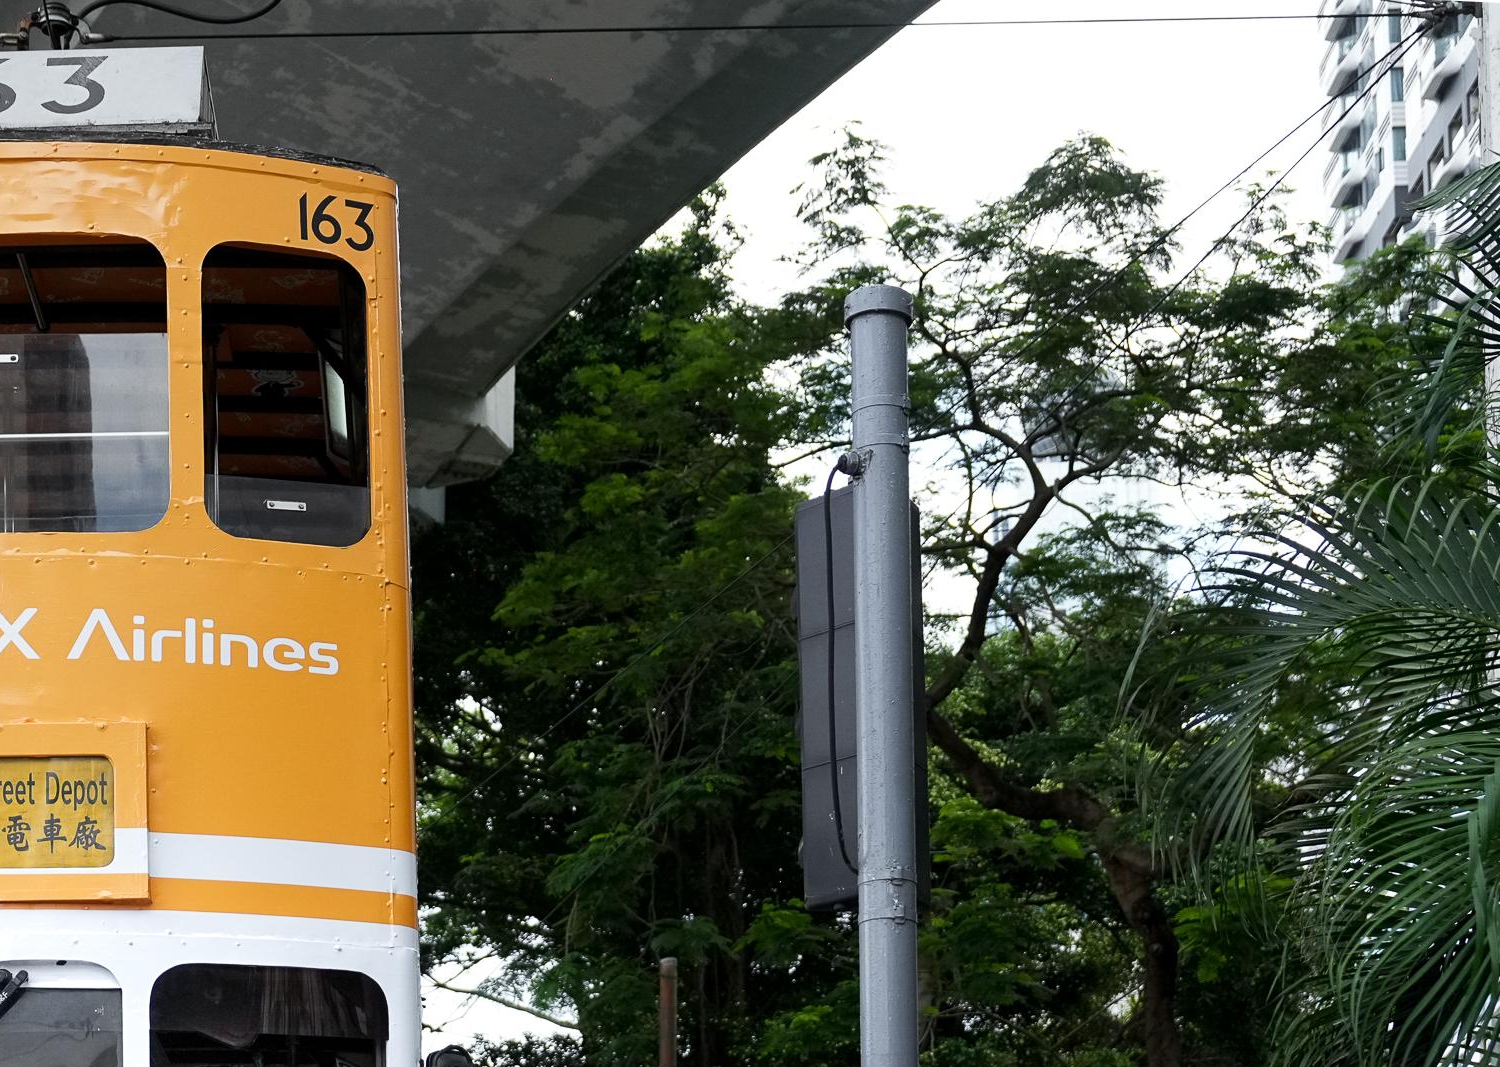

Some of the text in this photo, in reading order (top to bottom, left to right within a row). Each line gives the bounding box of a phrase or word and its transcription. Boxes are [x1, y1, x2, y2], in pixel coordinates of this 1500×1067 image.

[299, 192, 375, 252] 163
[67, 608, 340, 676] Airlines
[46, 771, 108, 811] Depot
